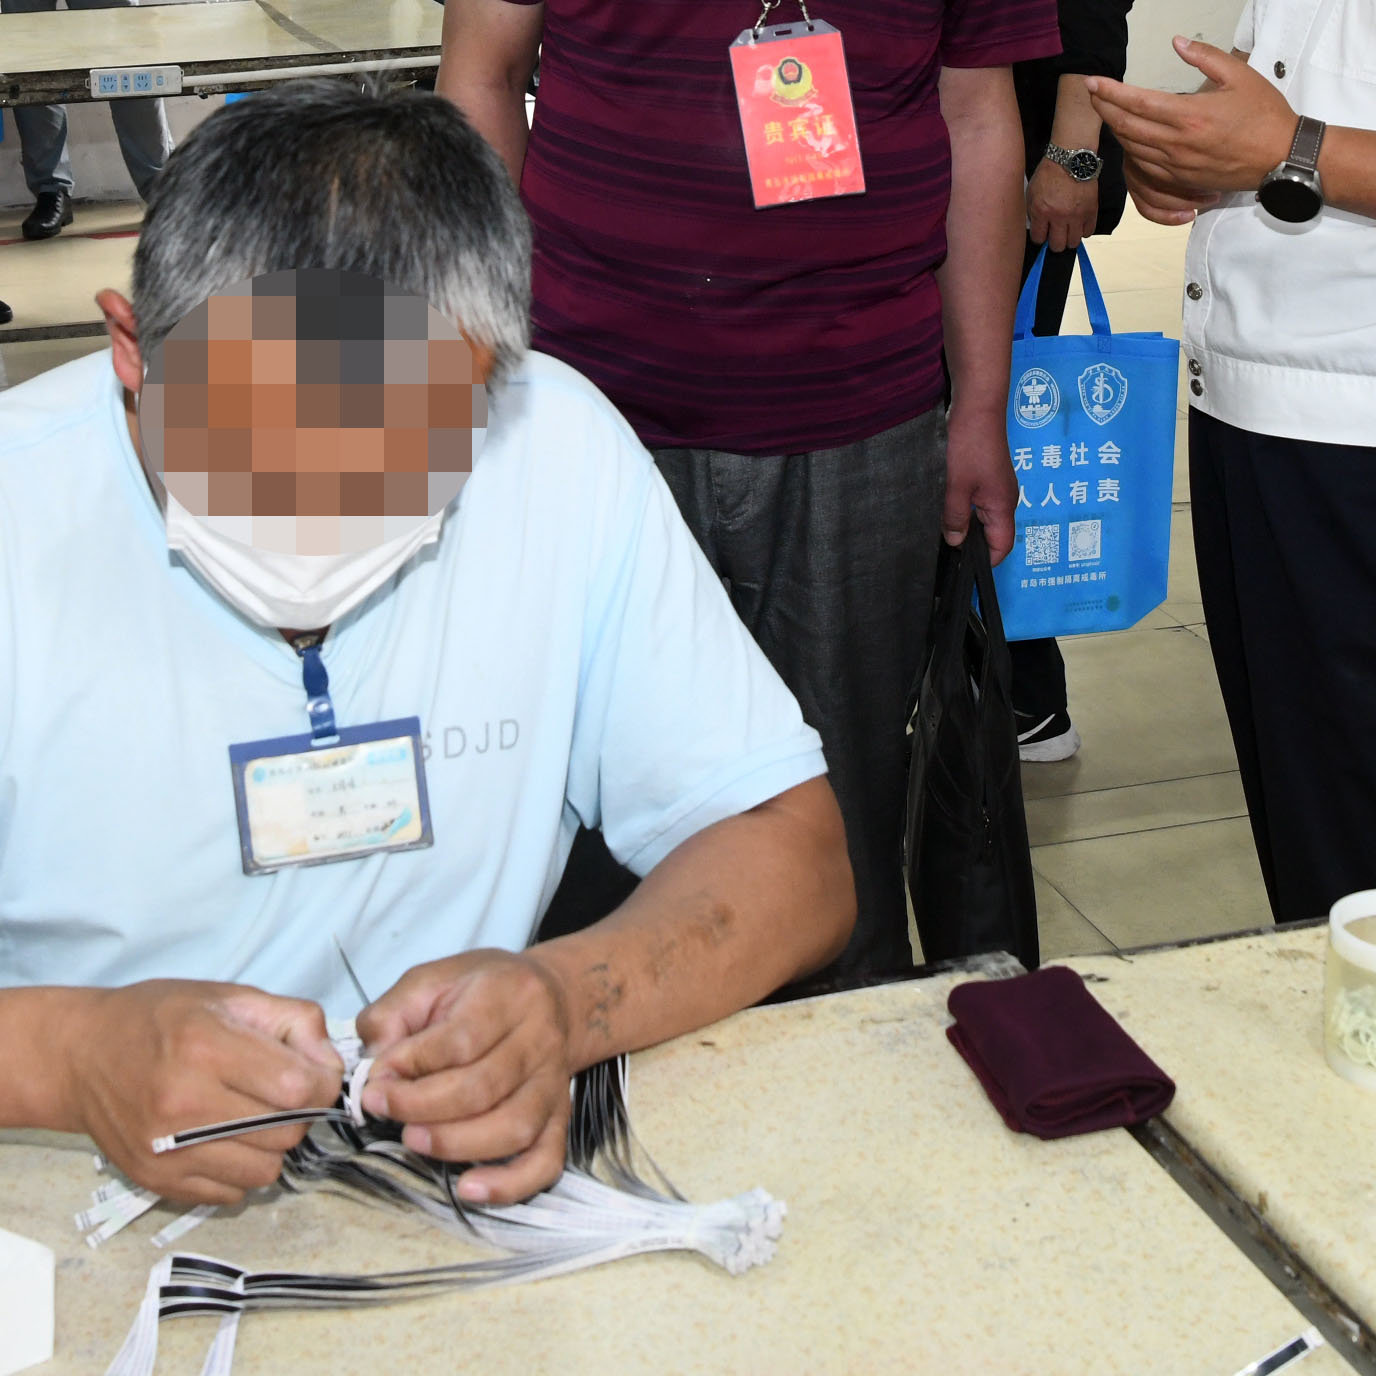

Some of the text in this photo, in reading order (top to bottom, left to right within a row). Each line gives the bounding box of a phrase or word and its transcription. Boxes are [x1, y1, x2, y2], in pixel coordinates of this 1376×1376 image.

[763, 113, 837, 145] 贵宾证
[1014, 440, 1121, 472] 无毒社会
[1016, 478, 1120, 509] 人人有责
